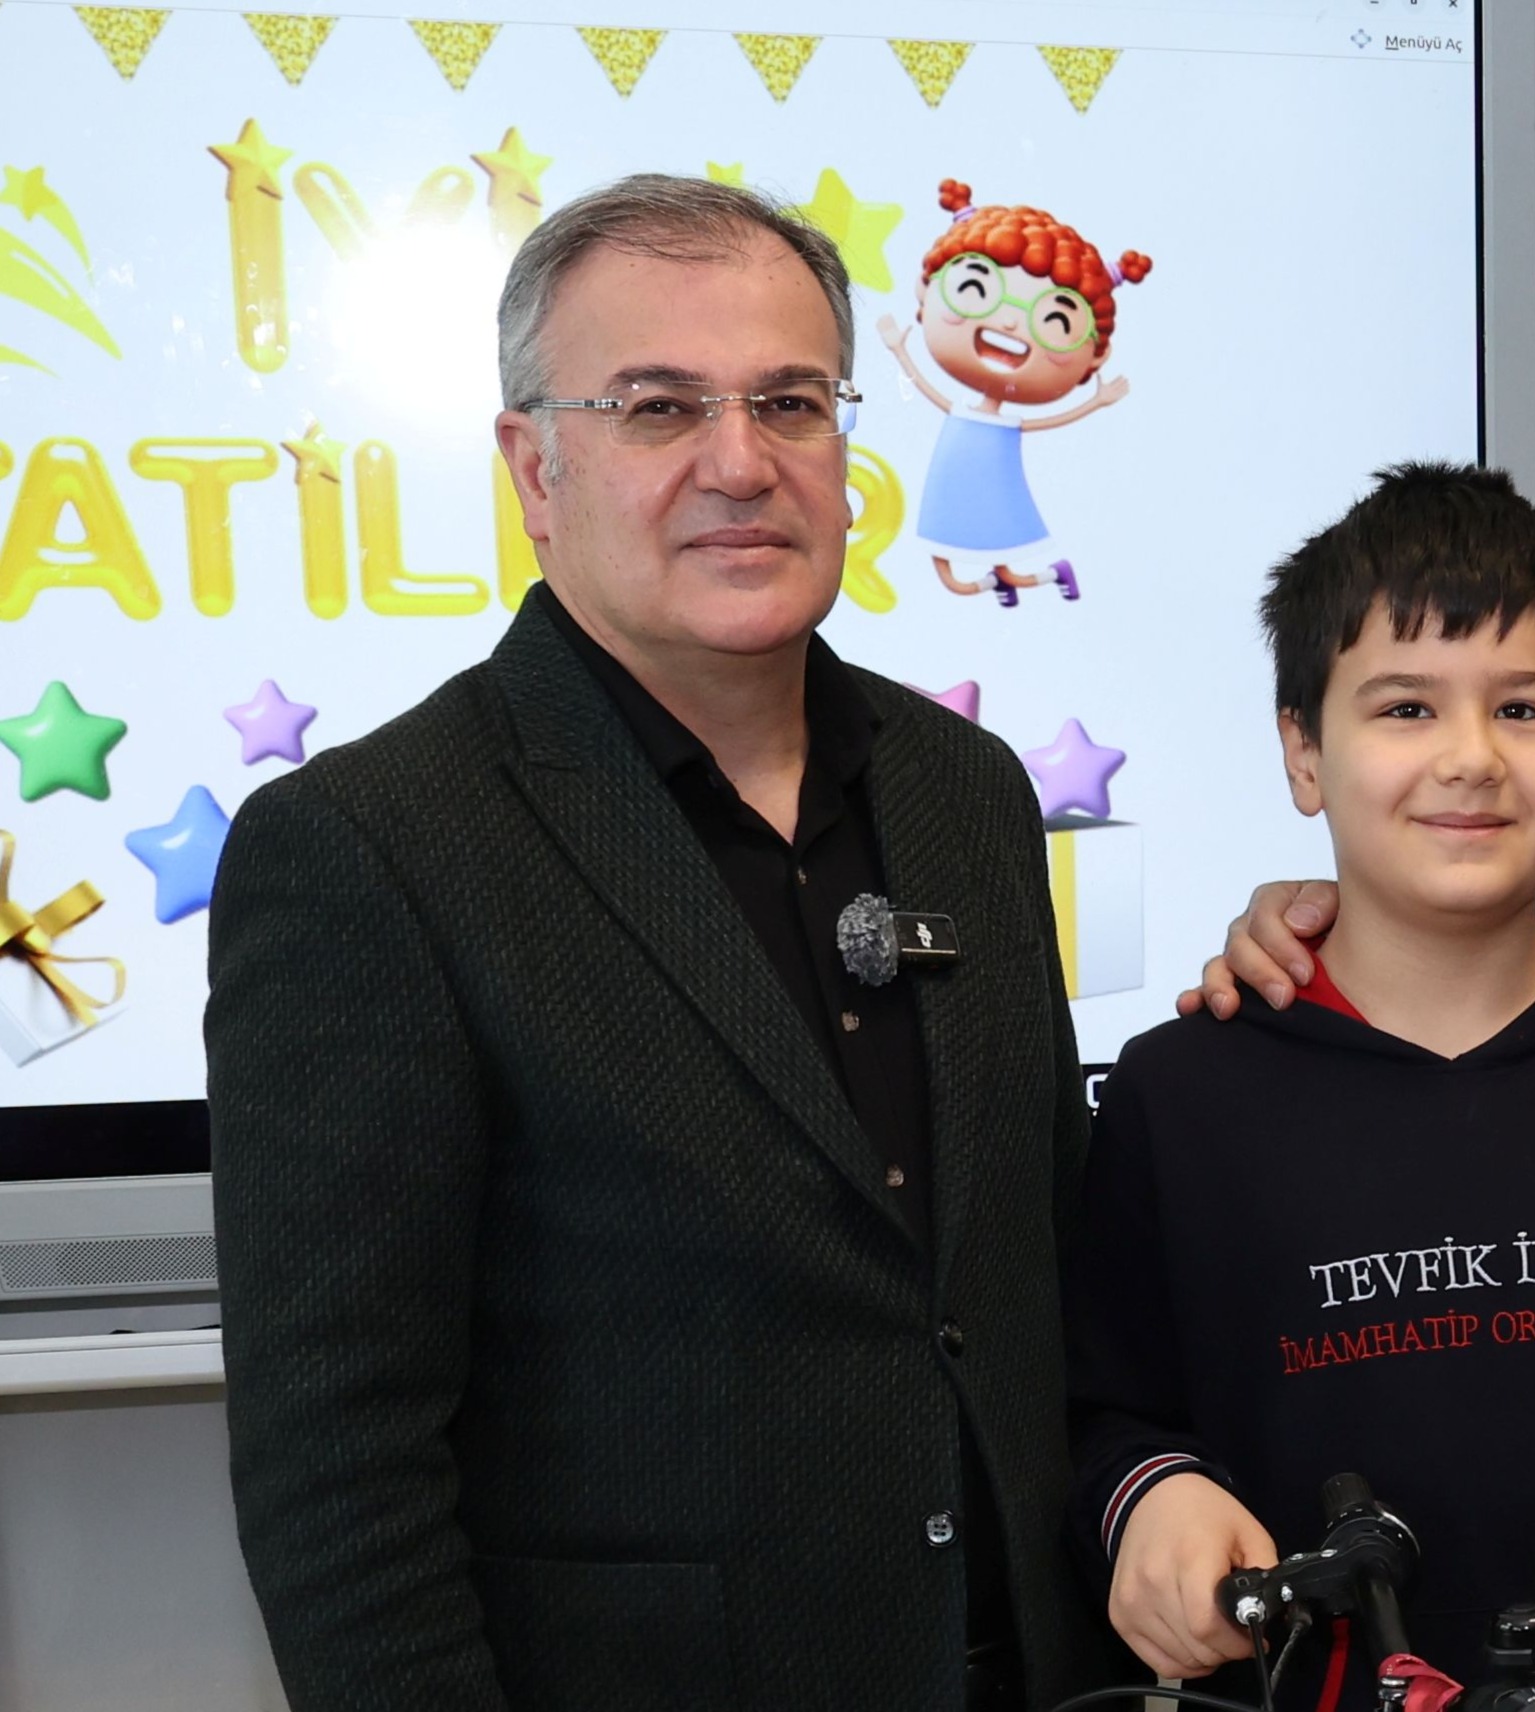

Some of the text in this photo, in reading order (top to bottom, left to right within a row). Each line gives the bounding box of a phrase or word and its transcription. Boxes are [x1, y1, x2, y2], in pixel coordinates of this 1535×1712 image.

[1385, 35, 1463, 54] Menüyü Aç
[1309, 1236, 1502, 1308] TEVFİK
[1280, 1309, 1479, 1375] İMAMHATİP
